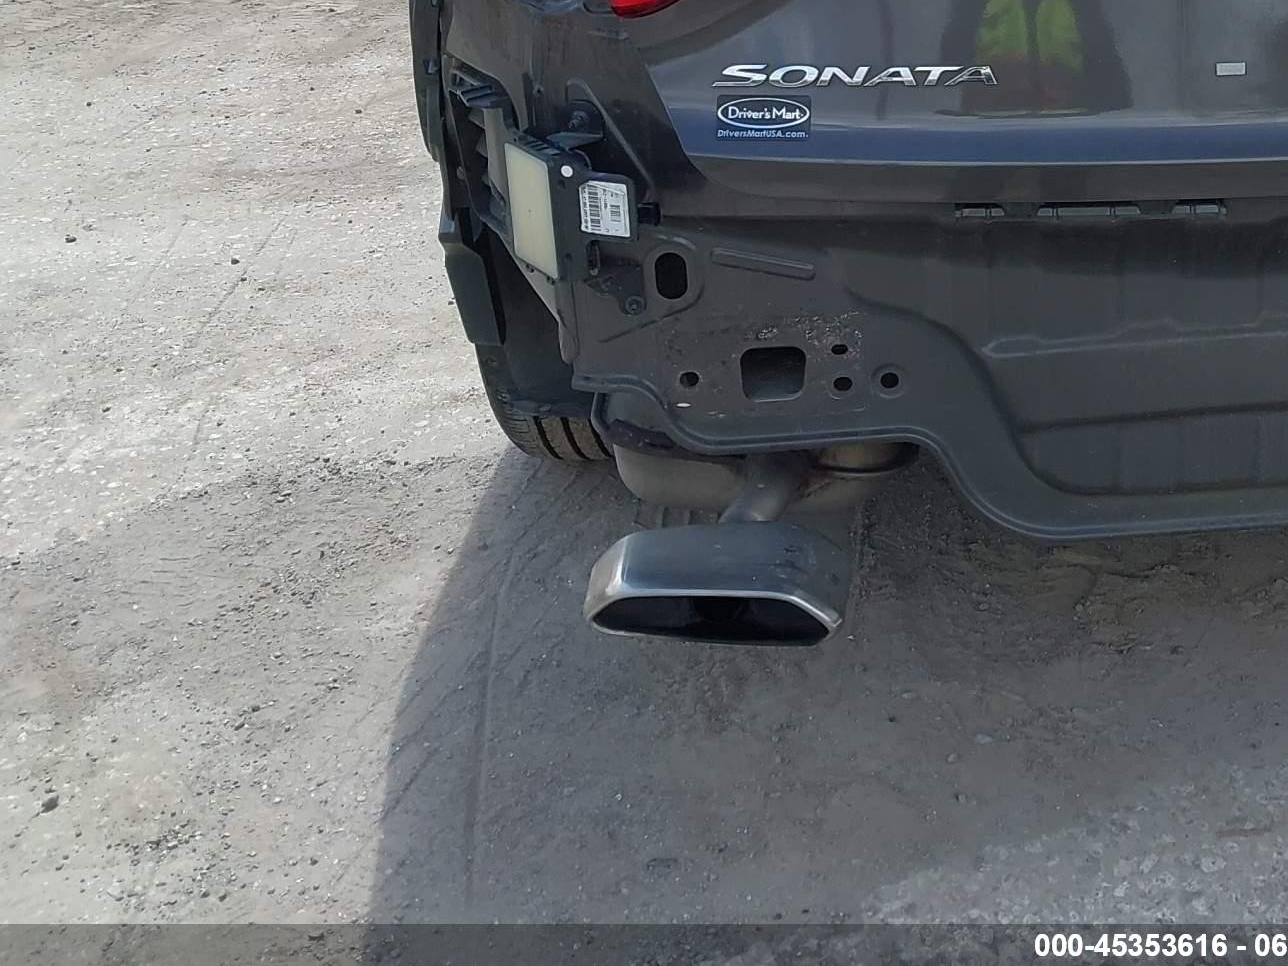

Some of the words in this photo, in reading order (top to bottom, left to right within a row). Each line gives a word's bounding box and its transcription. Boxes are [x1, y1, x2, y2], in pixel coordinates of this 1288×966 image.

[711, 64, 998, 87] SONATA
[727, 105, 771, 120] Driver's
[772, 105, 801, 120] Mart
